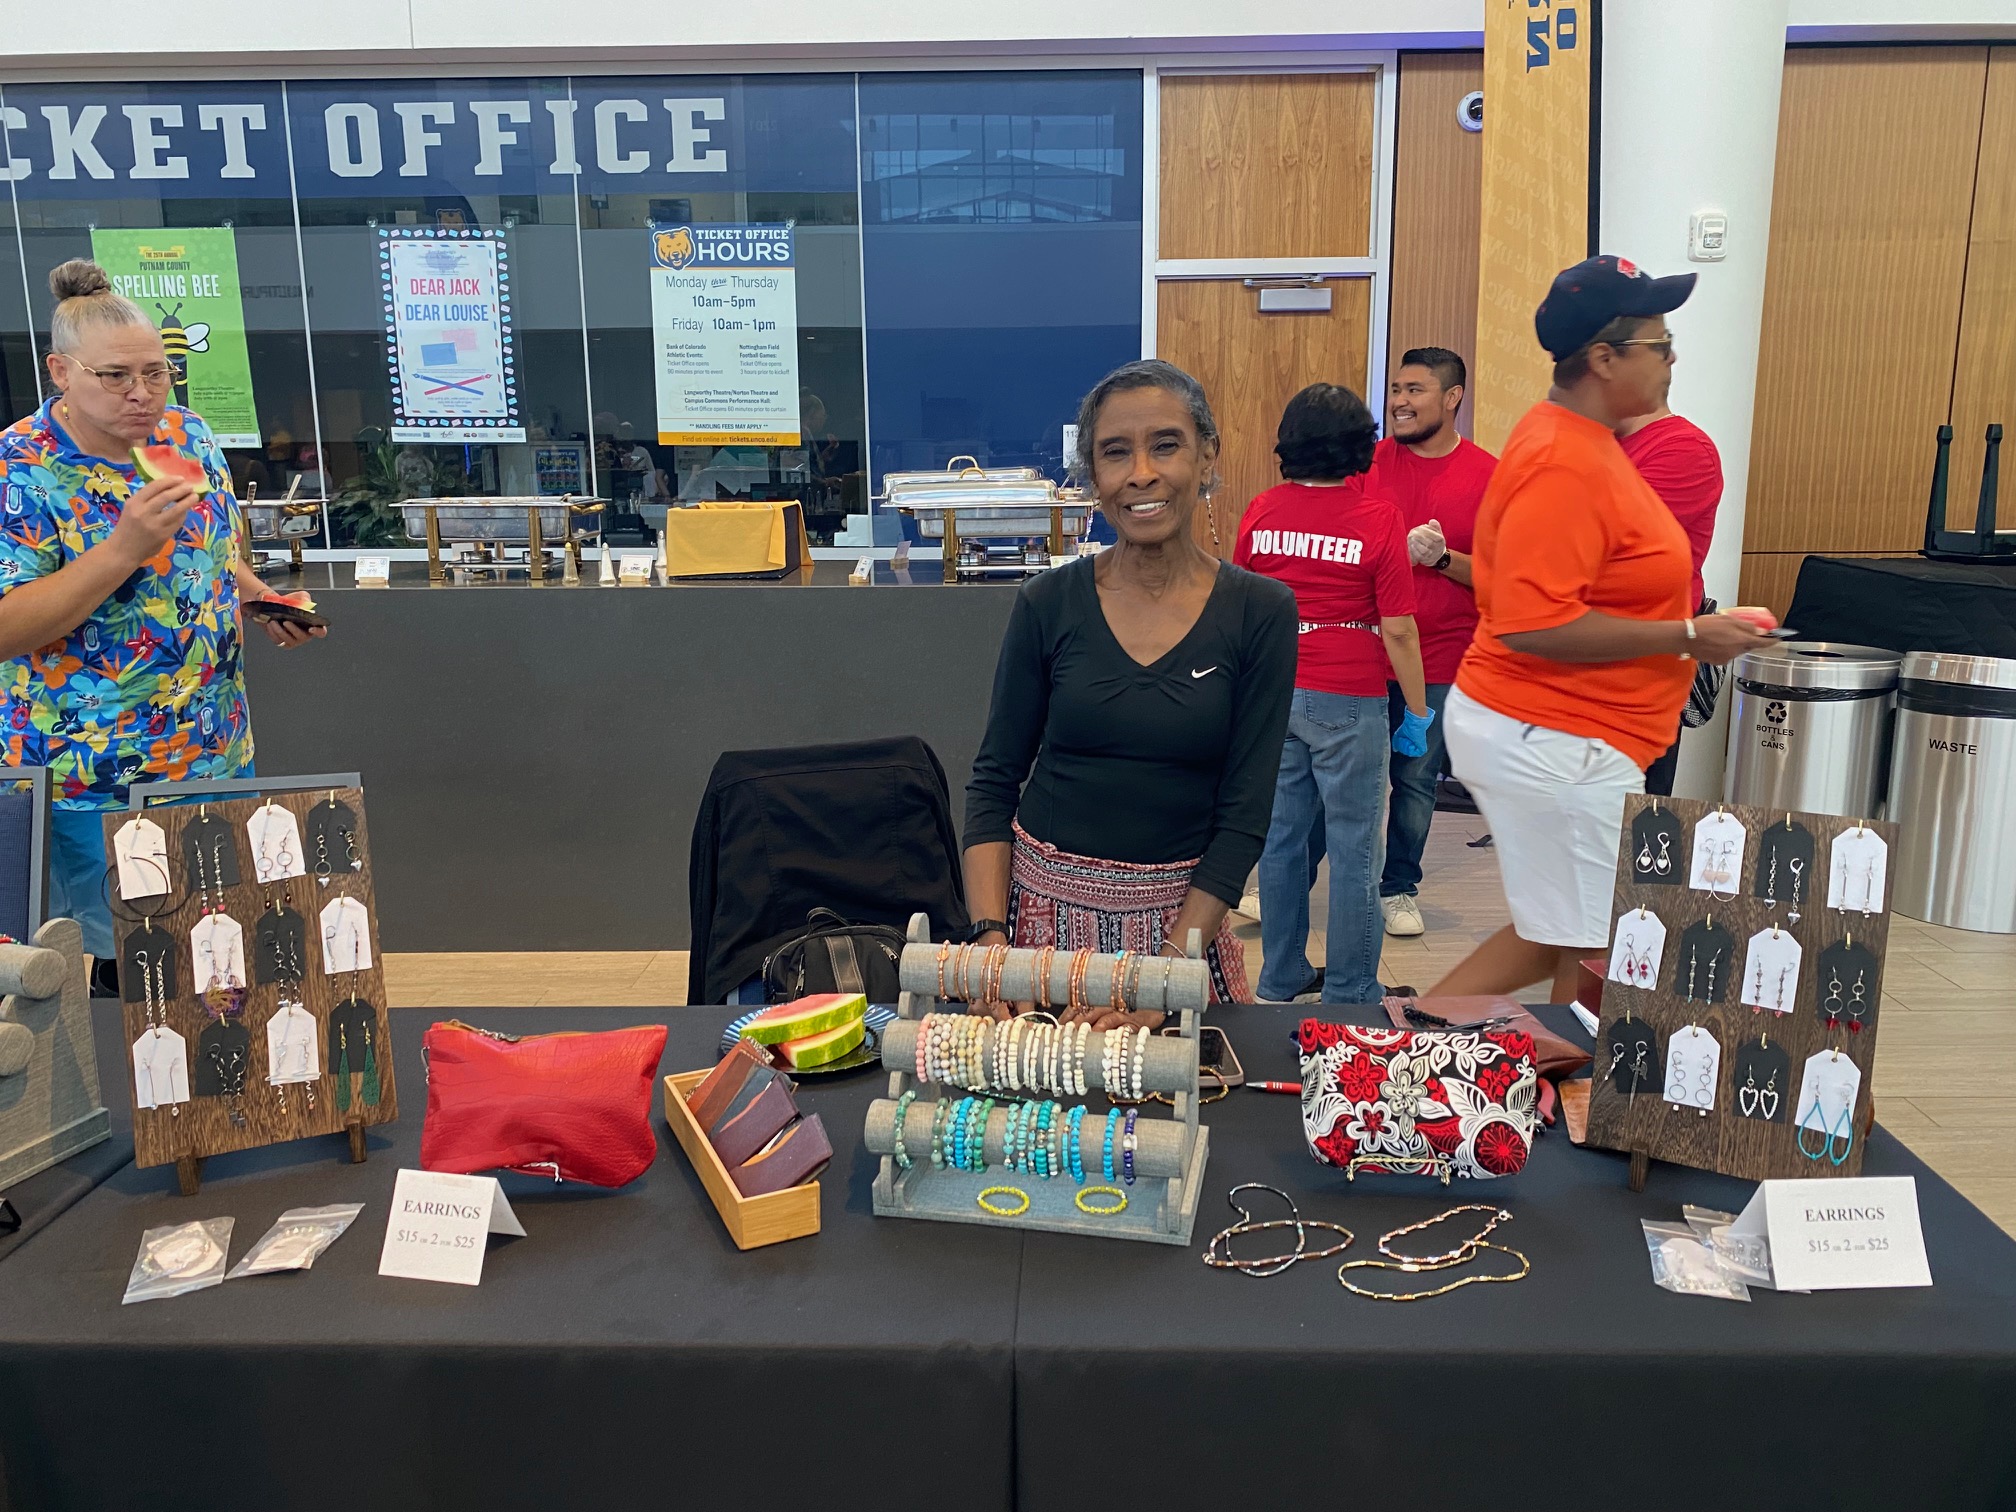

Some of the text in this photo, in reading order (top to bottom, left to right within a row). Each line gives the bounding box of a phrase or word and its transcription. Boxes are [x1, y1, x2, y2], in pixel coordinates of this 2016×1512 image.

[324, 98, 727, 177] OFFICE
[696, 230, 789, 239] TICKET OFFICE
[698, 242, 790, 261] HOURS
[139, 262, 190, 271] PUTNAM COUNTY
[113, 274, 221, 298] SPELLING BEE
[410, 278, 480, 295] DEAR JACK
[666, 276, 779, 291] Monday thru Thursday
[406, 304, 489, 321] DEAR LOUISE
[672, 318, 704, 333] Friday
[1756, 724, 1794, 736] BOTTLES
[1761, 740, 1784, 750] CANS
[1929, 738, 1978, 755] WASTE
[403, 1200, 481, 1219] EARRINGS
[1806, 1207, 1885, 1222] EARRINGS
[397, 1229, 418, 1243] $15
[431, 1233, 439, 1245] 2
[454, 1235, 475, 1249] $25
[1809, 1240, 1830, 1252] $15
[1844, 1239, 1852, 1251] 2
[1868, 1238, 1889, 1251] $25
